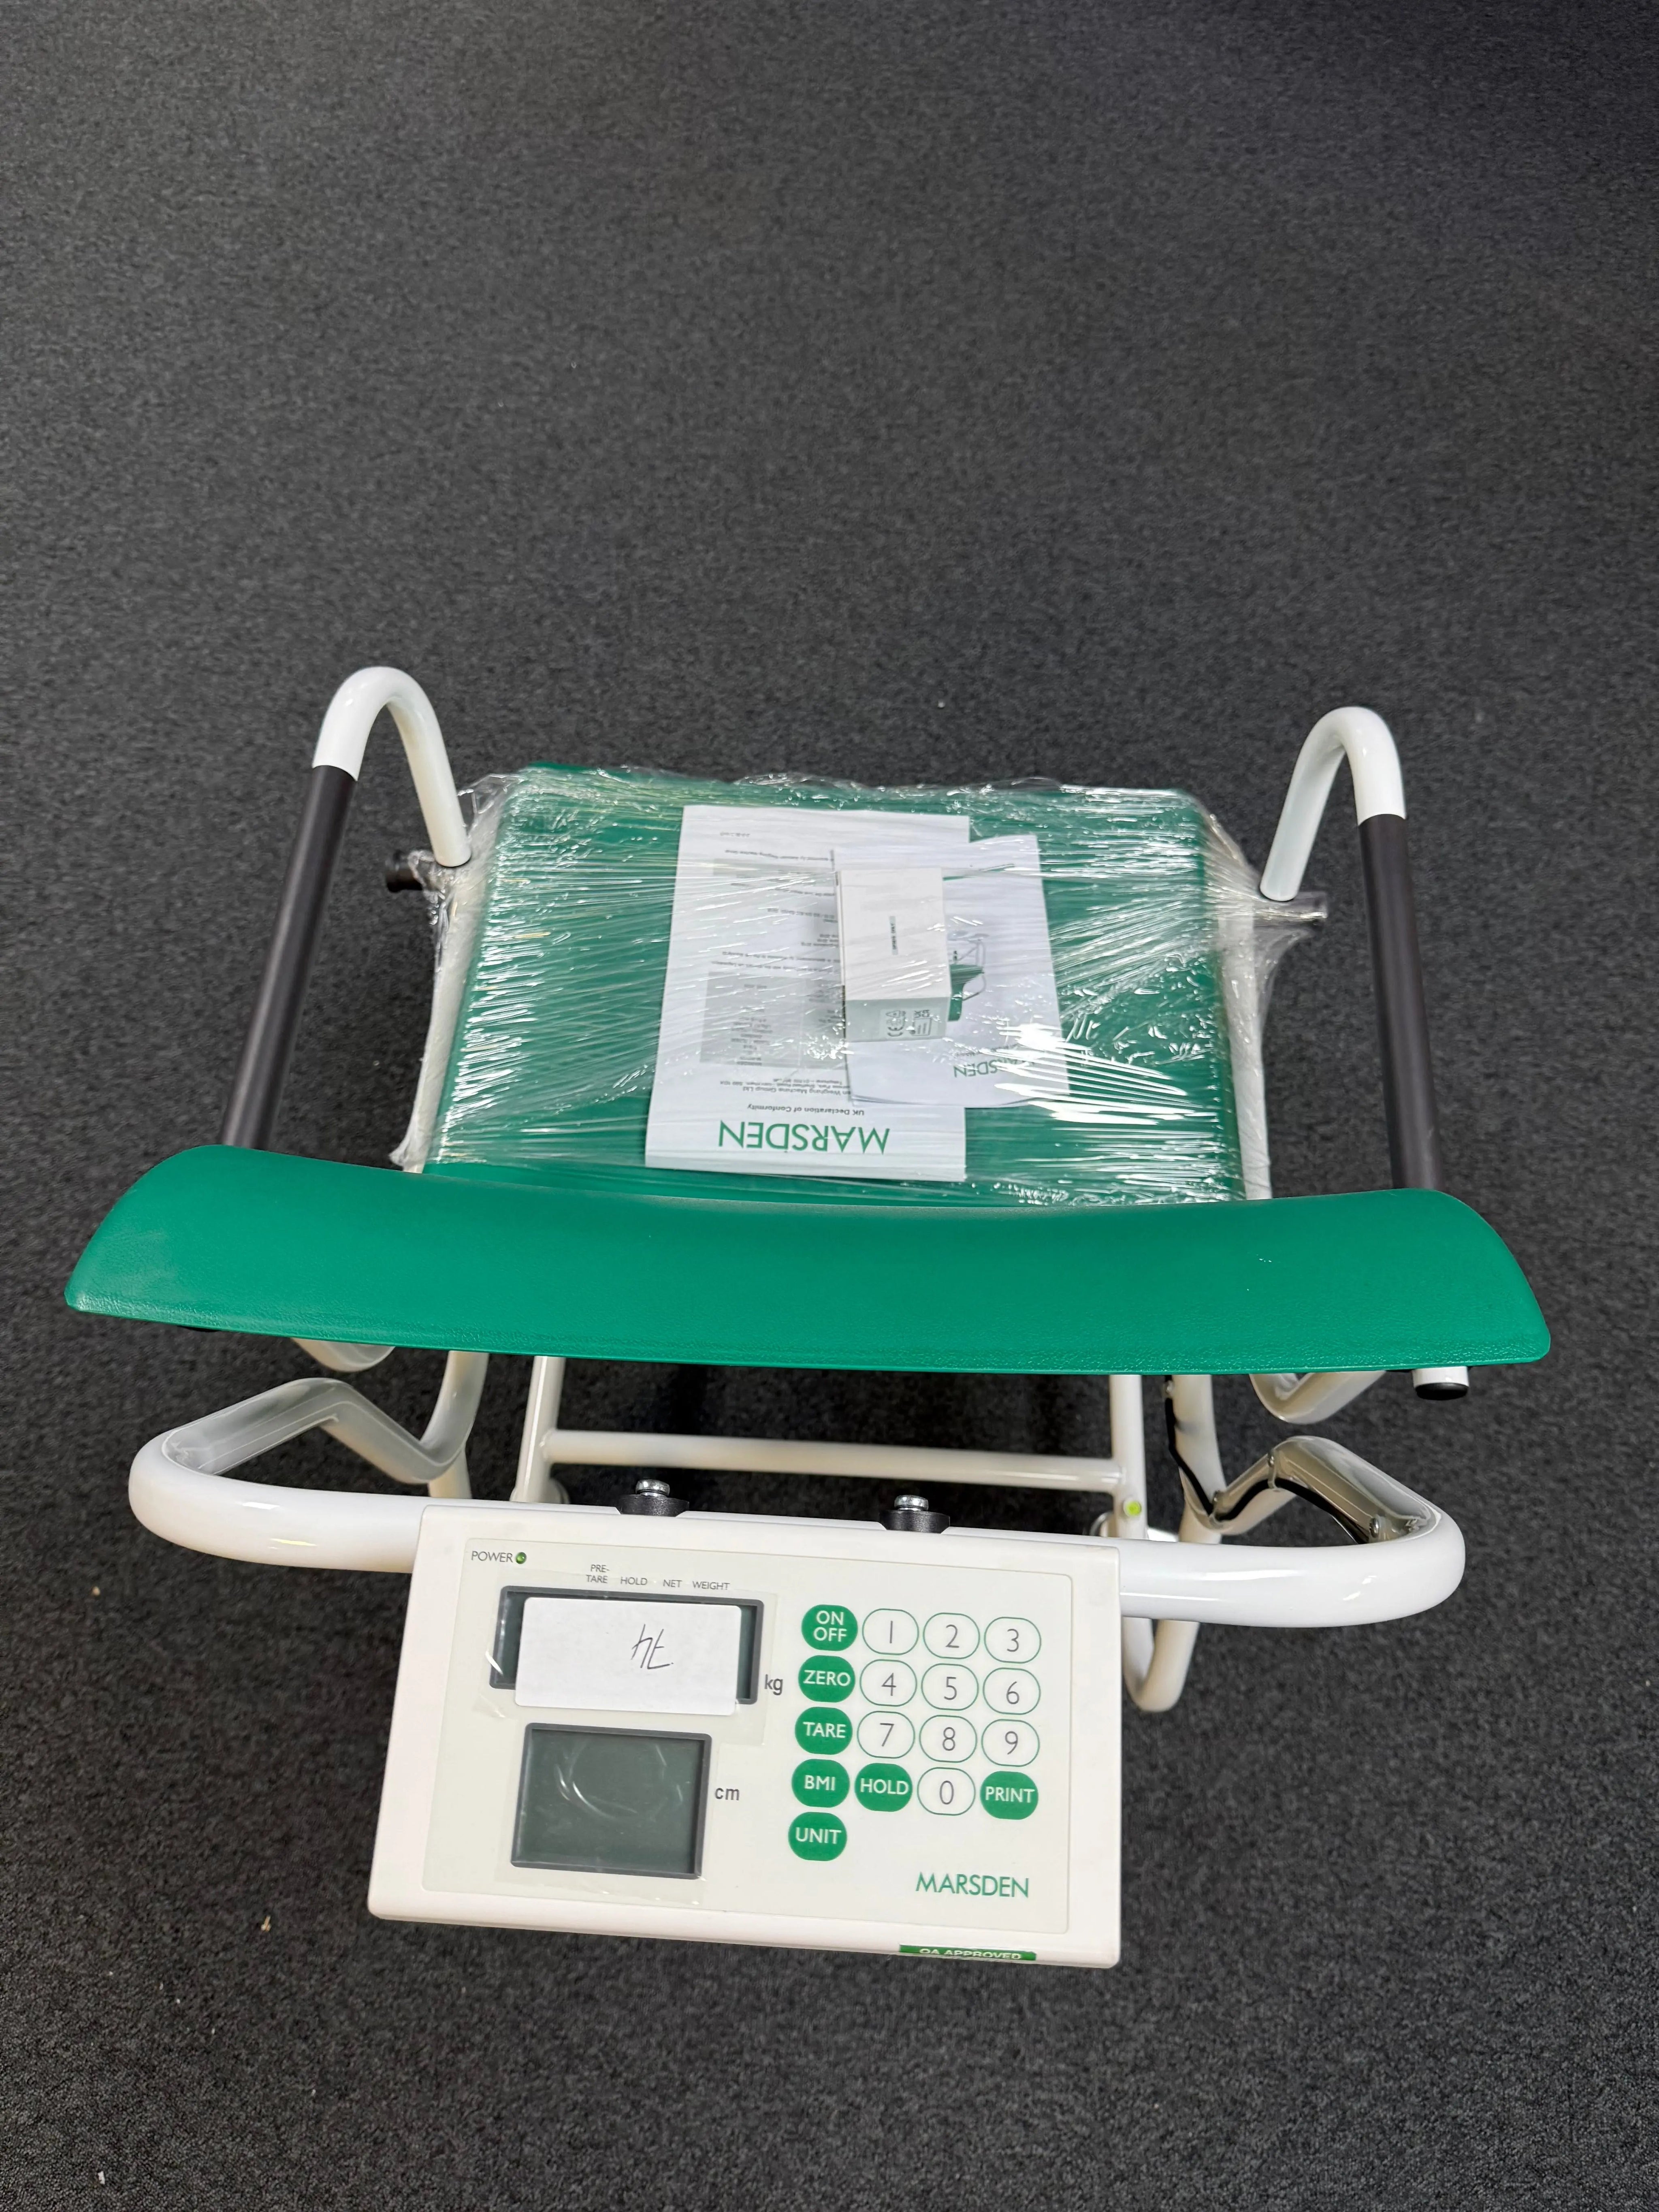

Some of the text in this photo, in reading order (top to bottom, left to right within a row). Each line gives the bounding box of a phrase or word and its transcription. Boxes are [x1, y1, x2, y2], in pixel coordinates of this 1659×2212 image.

[747, 1104, 792, 1113] Conformity
[804, 1107, 850, 1116] Declaration
[719, 1121, 889, 1154] MARSDEN
[471, 1551, 513, 1562] POWER
[591, 1564, 609, 1572] PRE-
[586, 1575, 608, 1583] TARE
[621, 1577, 647, 1585] HOLD
[693, 1581, 730, 1590] WEIGHT
[816, 1610, 844, 1625] ON
[813, 1627, 847, 1642] OFF
[946, 1625, 959, 1648] 2
[1007, 1629, 1019, 1652] 3
[765, 1674, 783, 1695] kg
[804, 1670, 851, 1686] ZERO
[881, 1673, 896, 1696] 4
[944, 1677, 957, 1700] 5
[1006, 1681, 1019, 1704] 6
[803, 1722, 846, 1738] TARE
[880, 1723, 894, 1747] 7
[943, 1727, 955, 1751] 8
[1005, 1731, 1018, 1754] 9
[804, 1775, 835, 1790] BMI
[860, 1778, 909, 1795] HOLD
[715, 1788, 739, 1800] cm
[940, 1781, 954, 1805] 0
[985, 1787, 1034, 1803] PRINT
[796, 1827, 841, 1844] UNIT
[916, 1873, 1028, 1897] MARSDEN
[944, 1950, 1021, 1960] APPROVED
